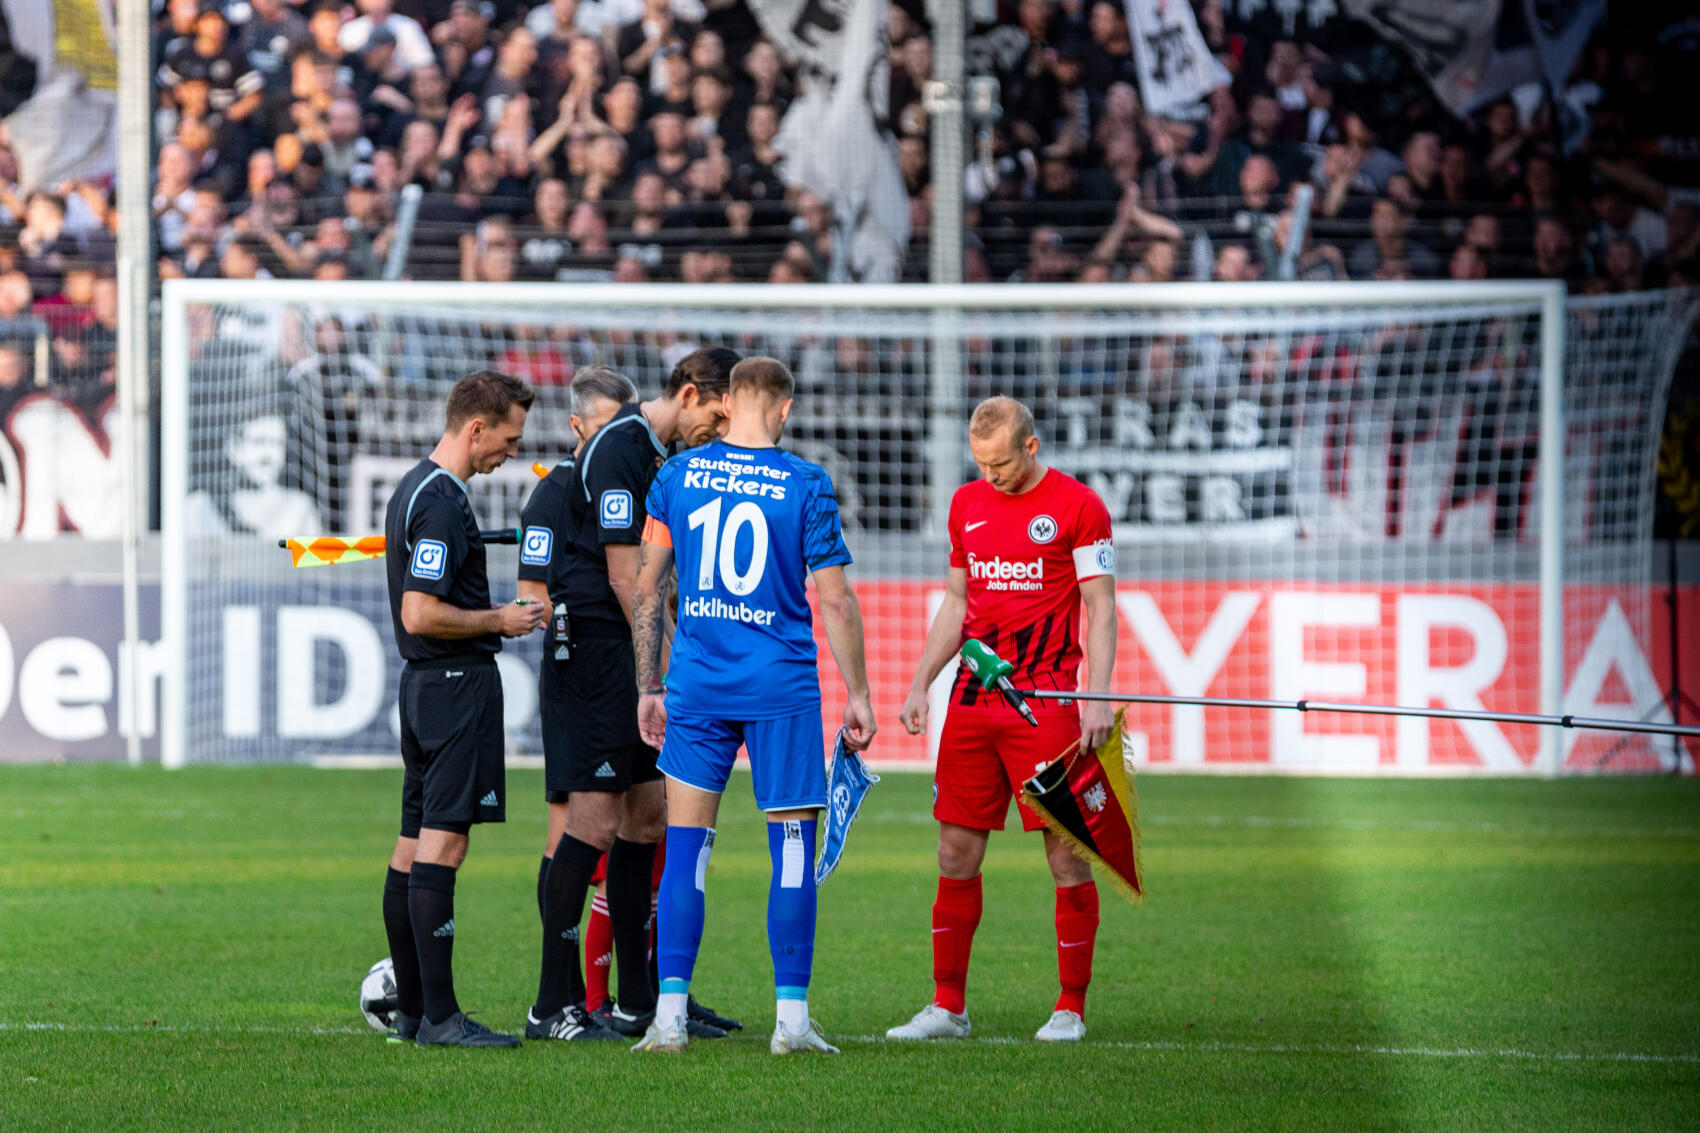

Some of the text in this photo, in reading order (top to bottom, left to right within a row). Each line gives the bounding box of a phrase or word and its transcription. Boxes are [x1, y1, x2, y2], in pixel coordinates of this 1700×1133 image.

[688, 457, 791, 481] Stuttgarter
[684, 471, 787, 501] Kickers
[688, 495, 769, 597] 10
[967, 553, 1043, 580] indeed
[986, 580, 1043, 591] Jobs finden
[684, 596, 776, 626] icklhuber
[0, 612, 164, 741] er
[928, 589, 1694, 776] YERA
